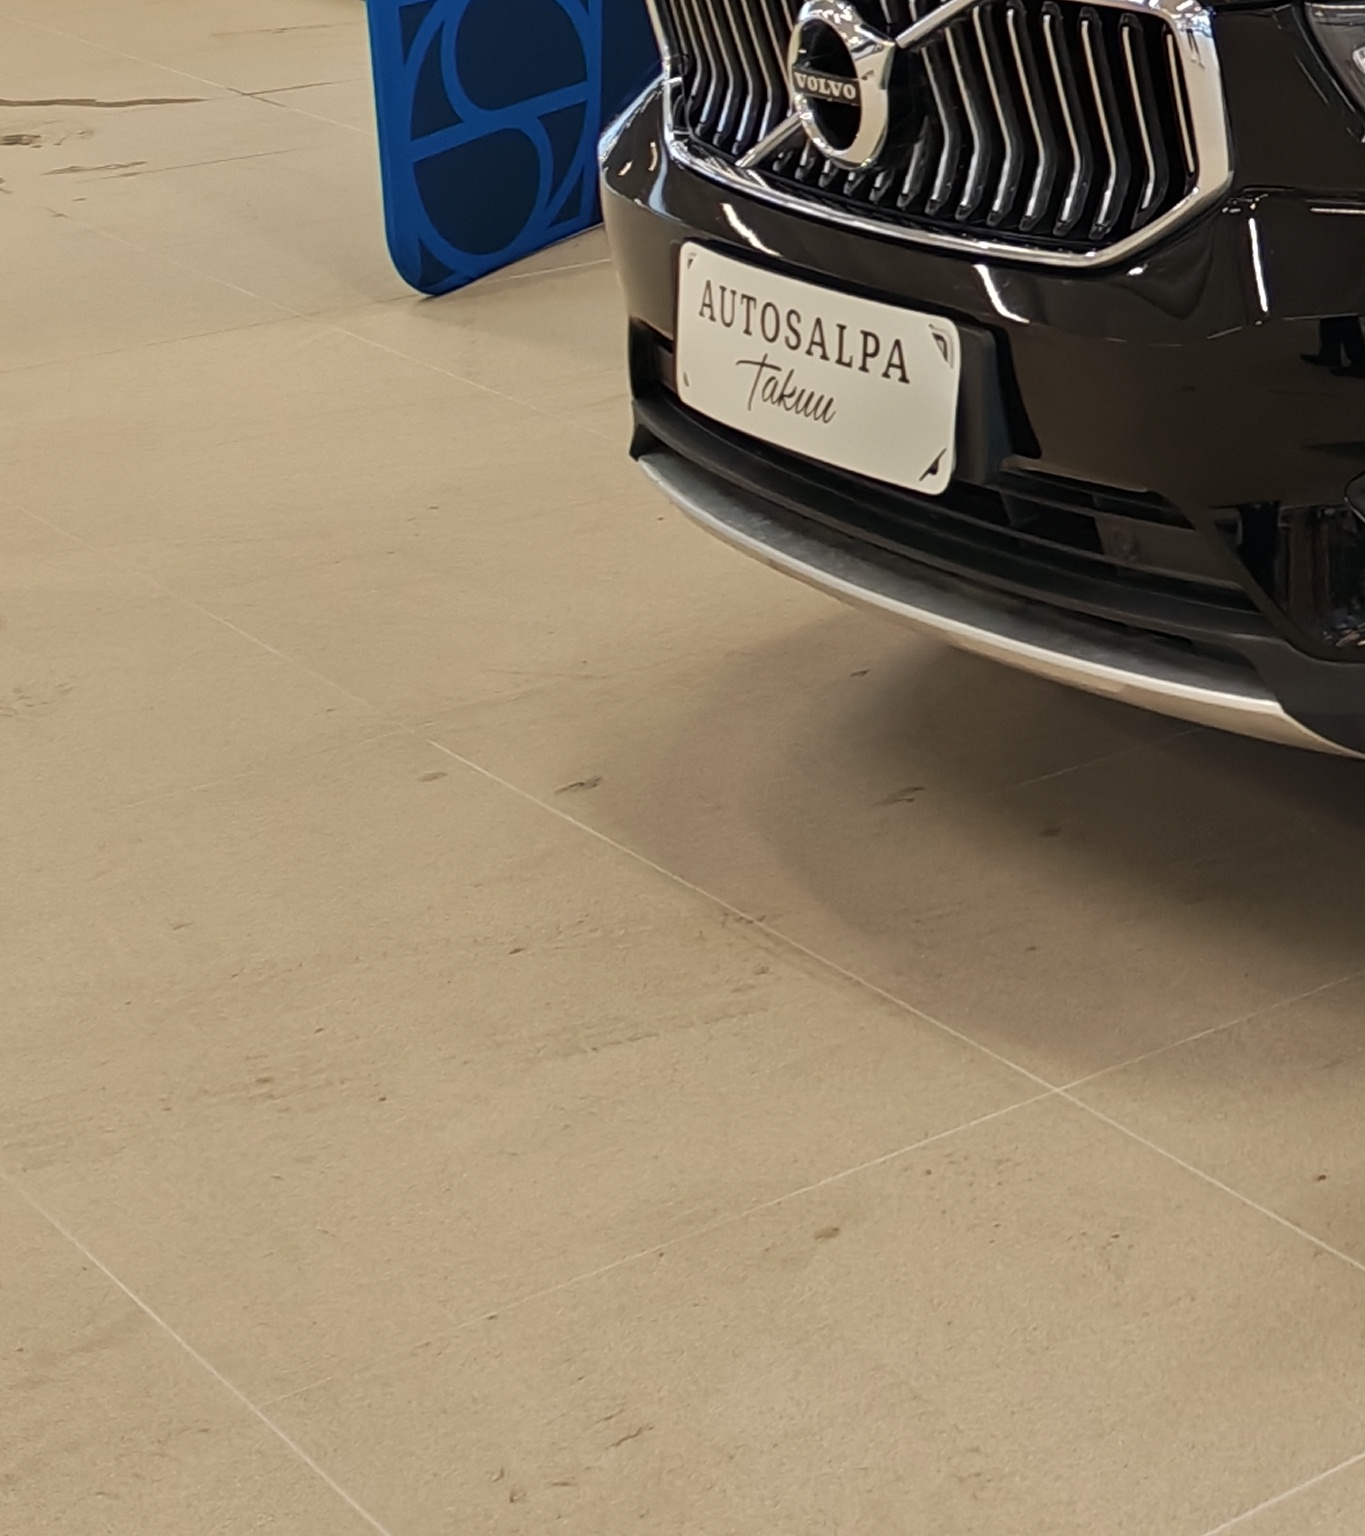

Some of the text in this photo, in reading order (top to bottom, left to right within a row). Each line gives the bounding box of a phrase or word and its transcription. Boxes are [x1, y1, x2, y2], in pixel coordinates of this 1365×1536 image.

[794, 71, 857, 99] VOLVO
[698, 279, 911, 384] AUTOSALPA
[735, 352, 837, 424] Takuu
